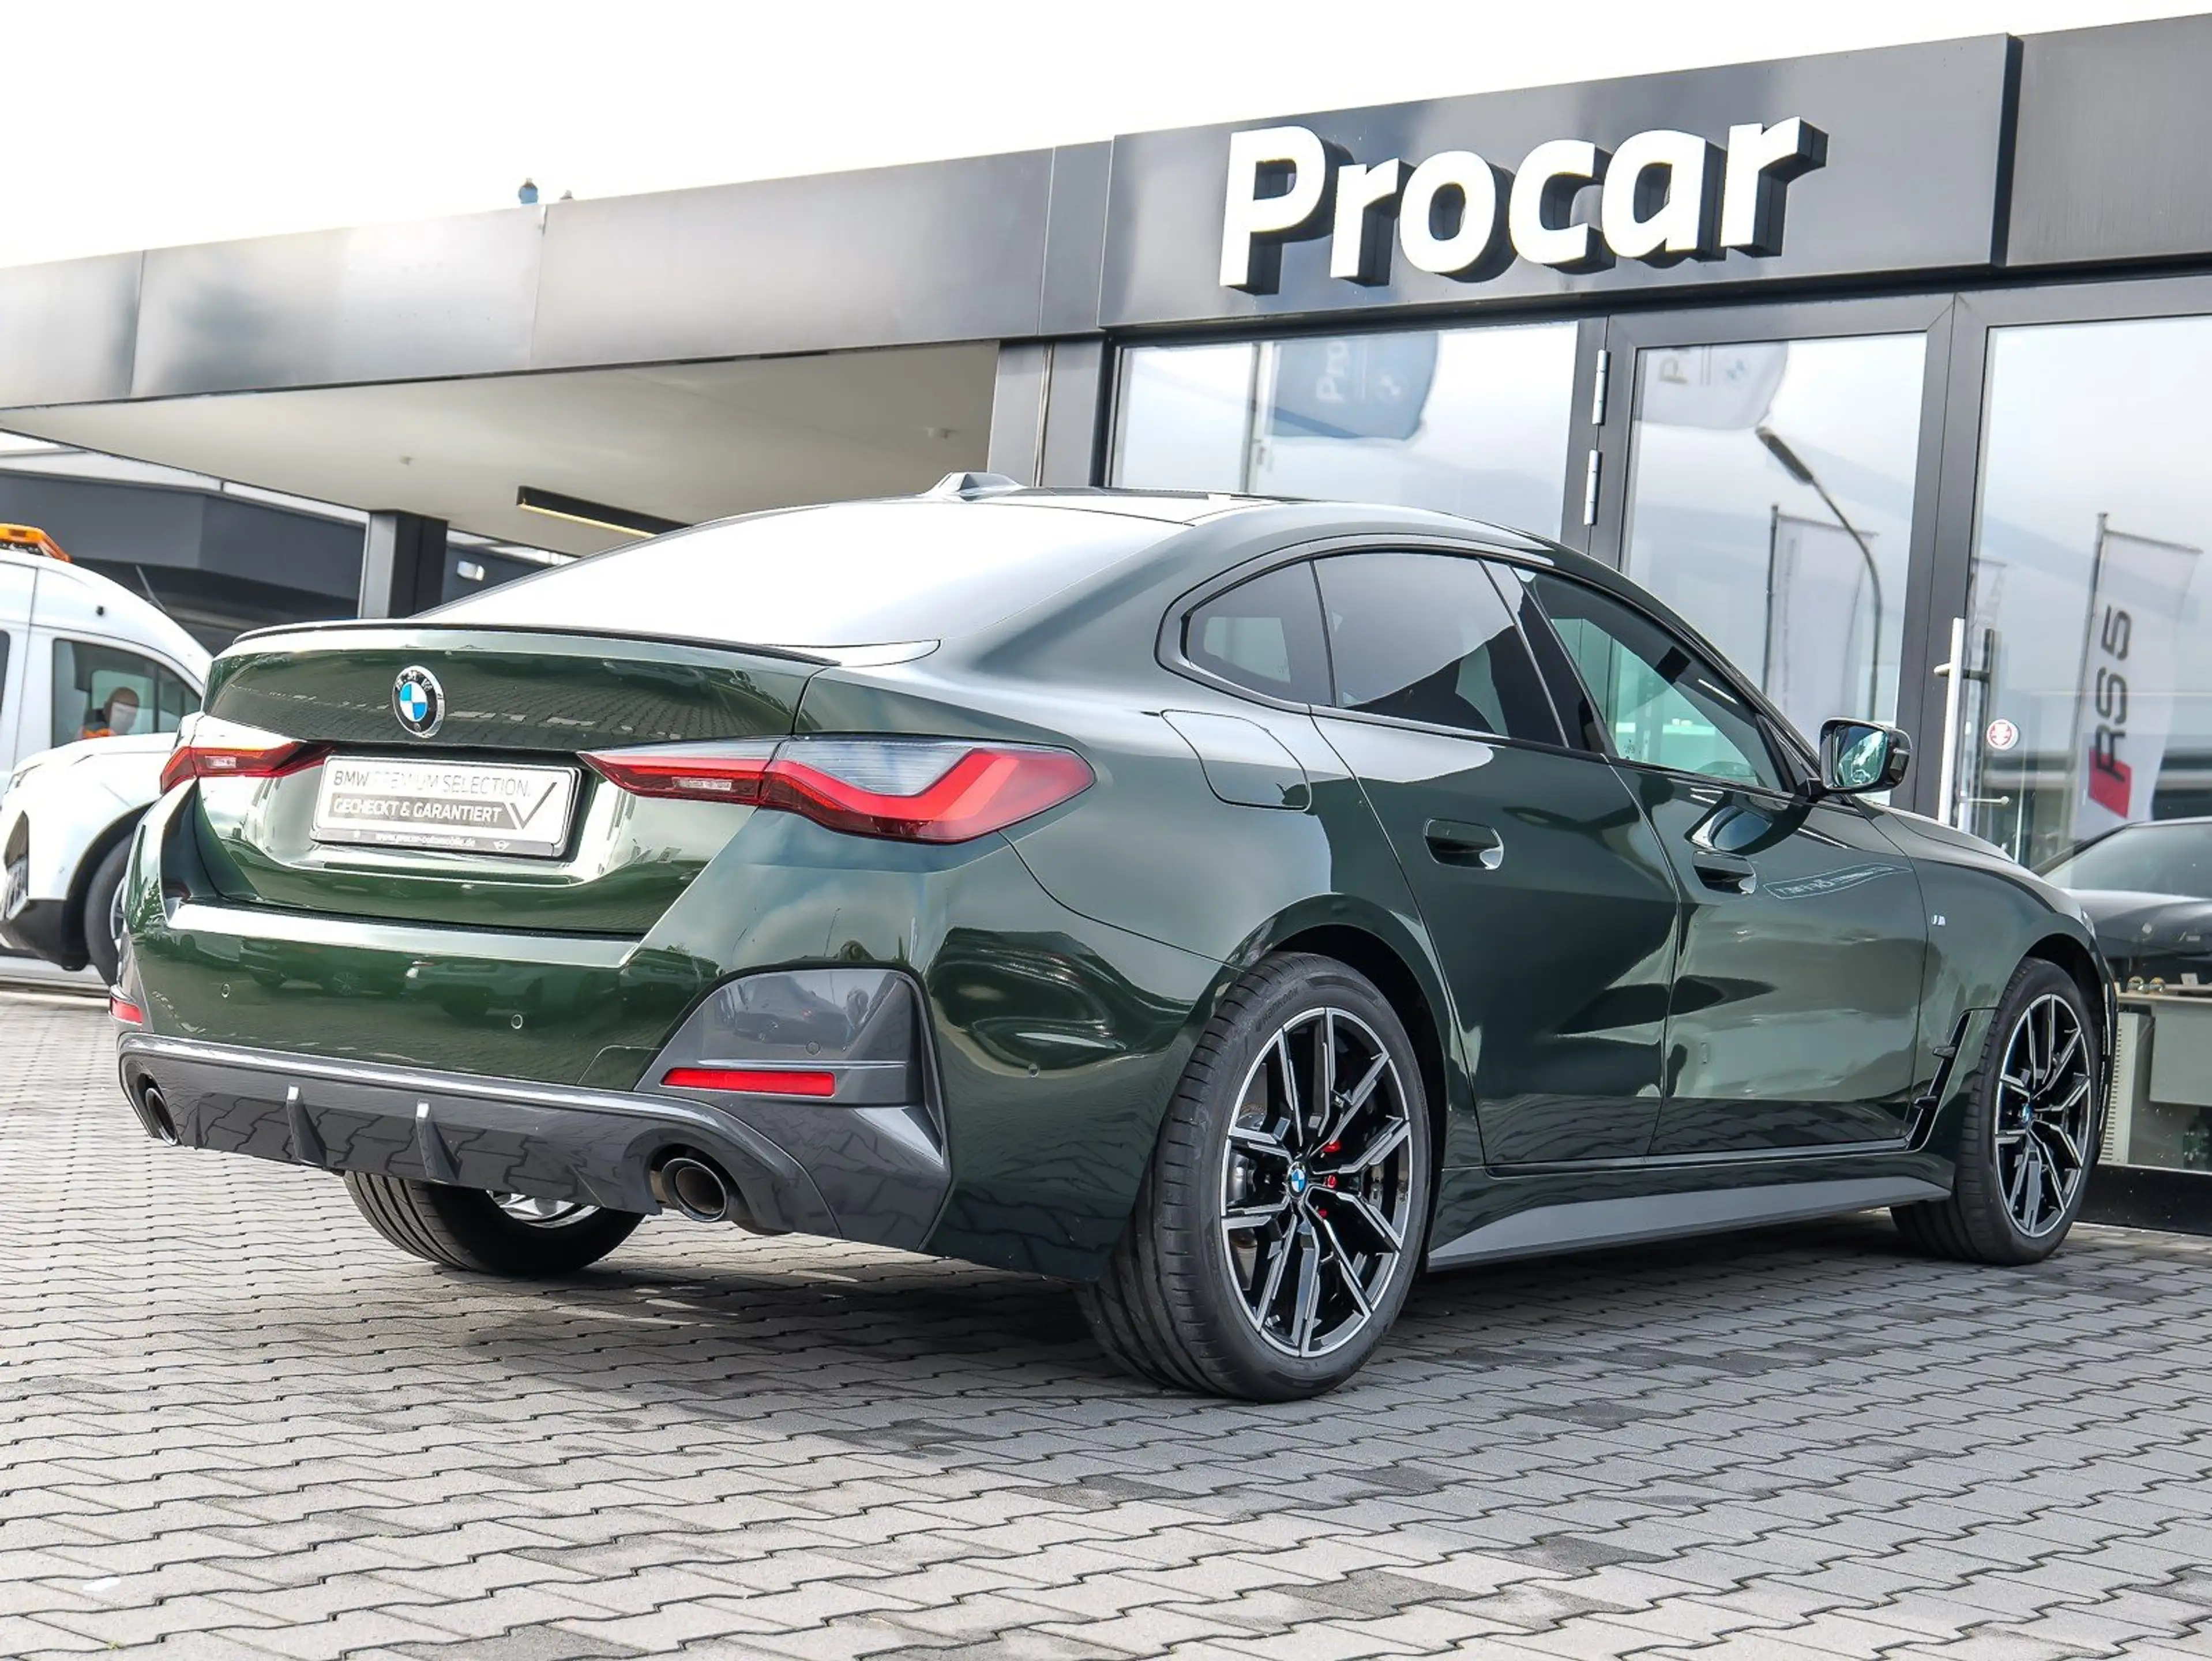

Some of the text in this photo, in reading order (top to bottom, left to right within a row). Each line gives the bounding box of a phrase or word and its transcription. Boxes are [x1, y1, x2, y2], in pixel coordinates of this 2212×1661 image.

[1219, 116, 1802, 290] Procar
[2094, 604, 2133, 784] RS 5
[333, 770, 369, 787] BMW
[335, 796, 501, 822] GECHECKT & GARANTIERT
